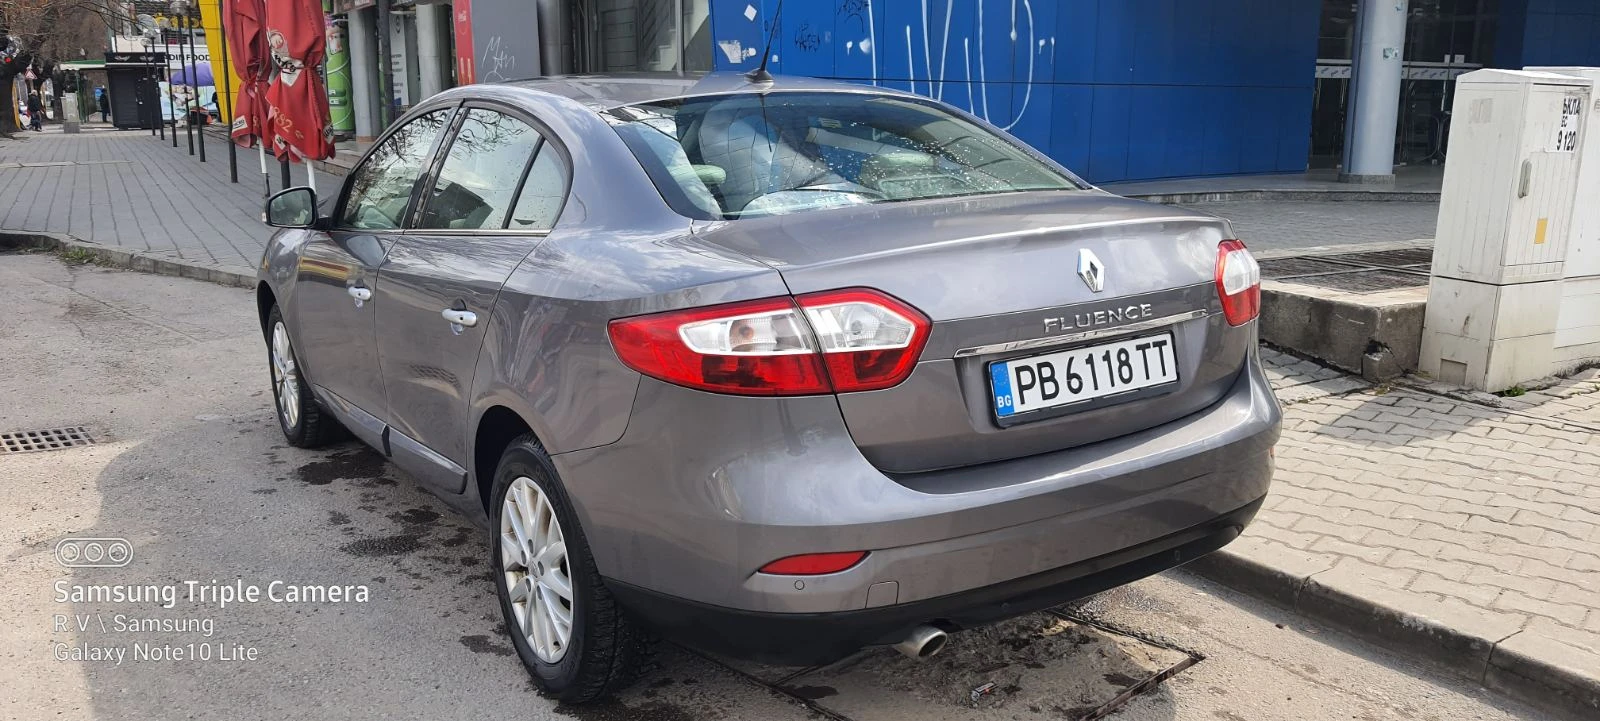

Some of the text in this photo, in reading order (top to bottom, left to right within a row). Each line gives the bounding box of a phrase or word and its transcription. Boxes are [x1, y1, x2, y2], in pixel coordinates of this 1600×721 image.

[1043, 303, 1153, 334] FLUENCE
[1014, 339, 1168, 405] PB 6118 TT
[997, 395, 1012, 408] BG
